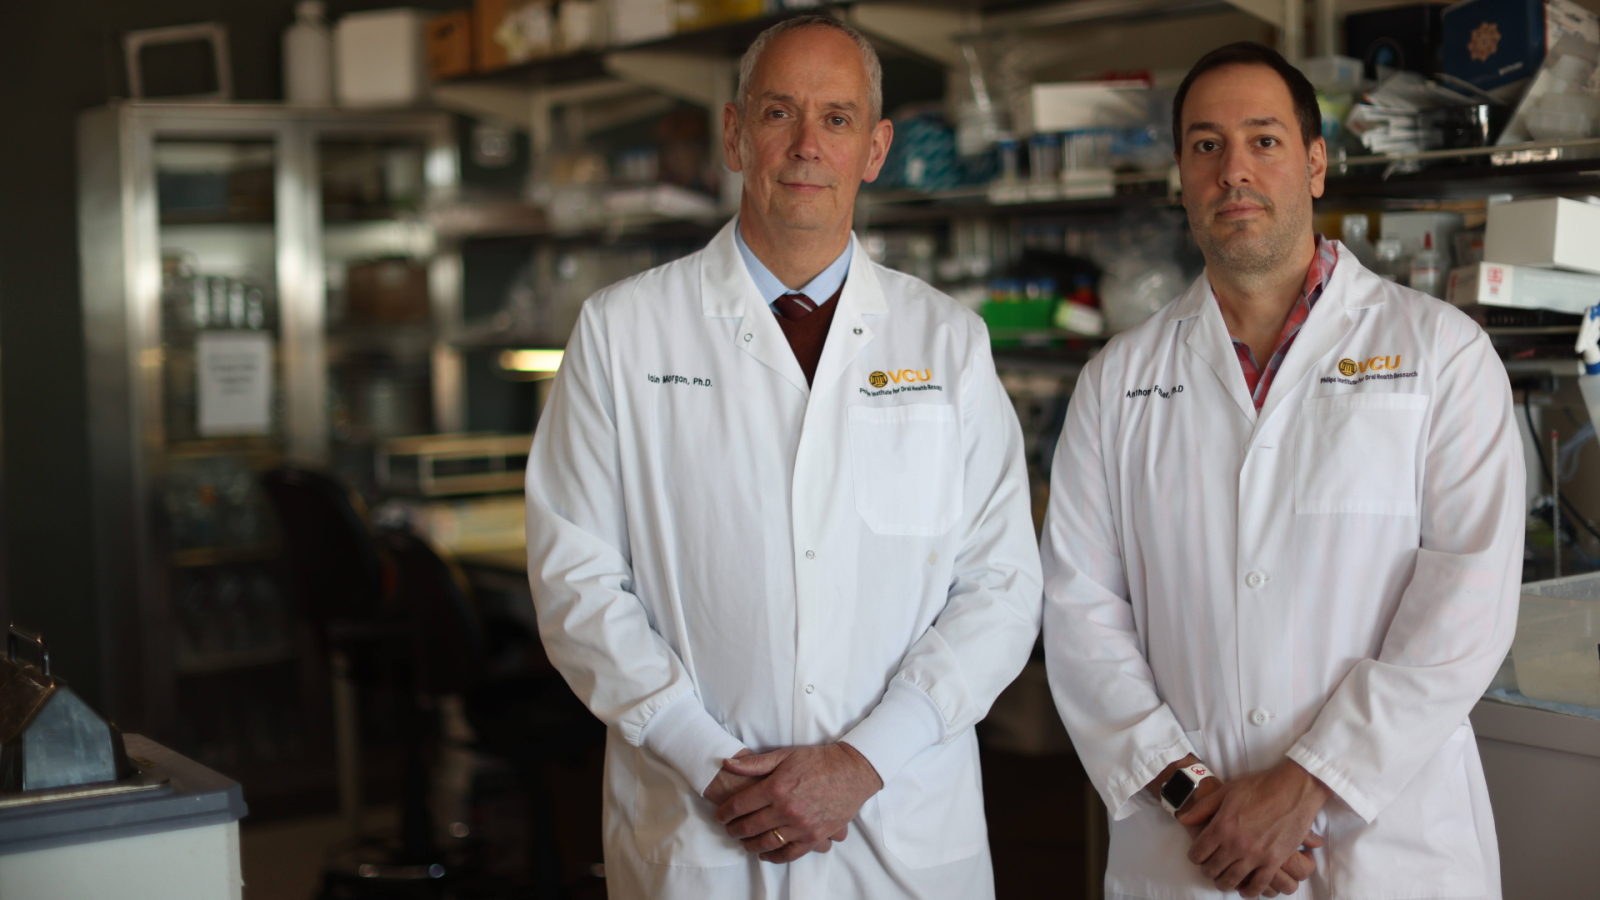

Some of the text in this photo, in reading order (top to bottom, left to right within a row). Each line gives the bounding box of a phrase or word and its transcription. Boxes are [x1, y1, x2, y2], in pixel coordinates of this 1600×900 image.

[1358, 354, 1402, 374] VCU
[647, 373, 660, 384] Iain
[693, 377, 713, 387] Ph.D.
[887, 368, 932, 384] VCU
[1126, 388, 1152, 399] Anthon
